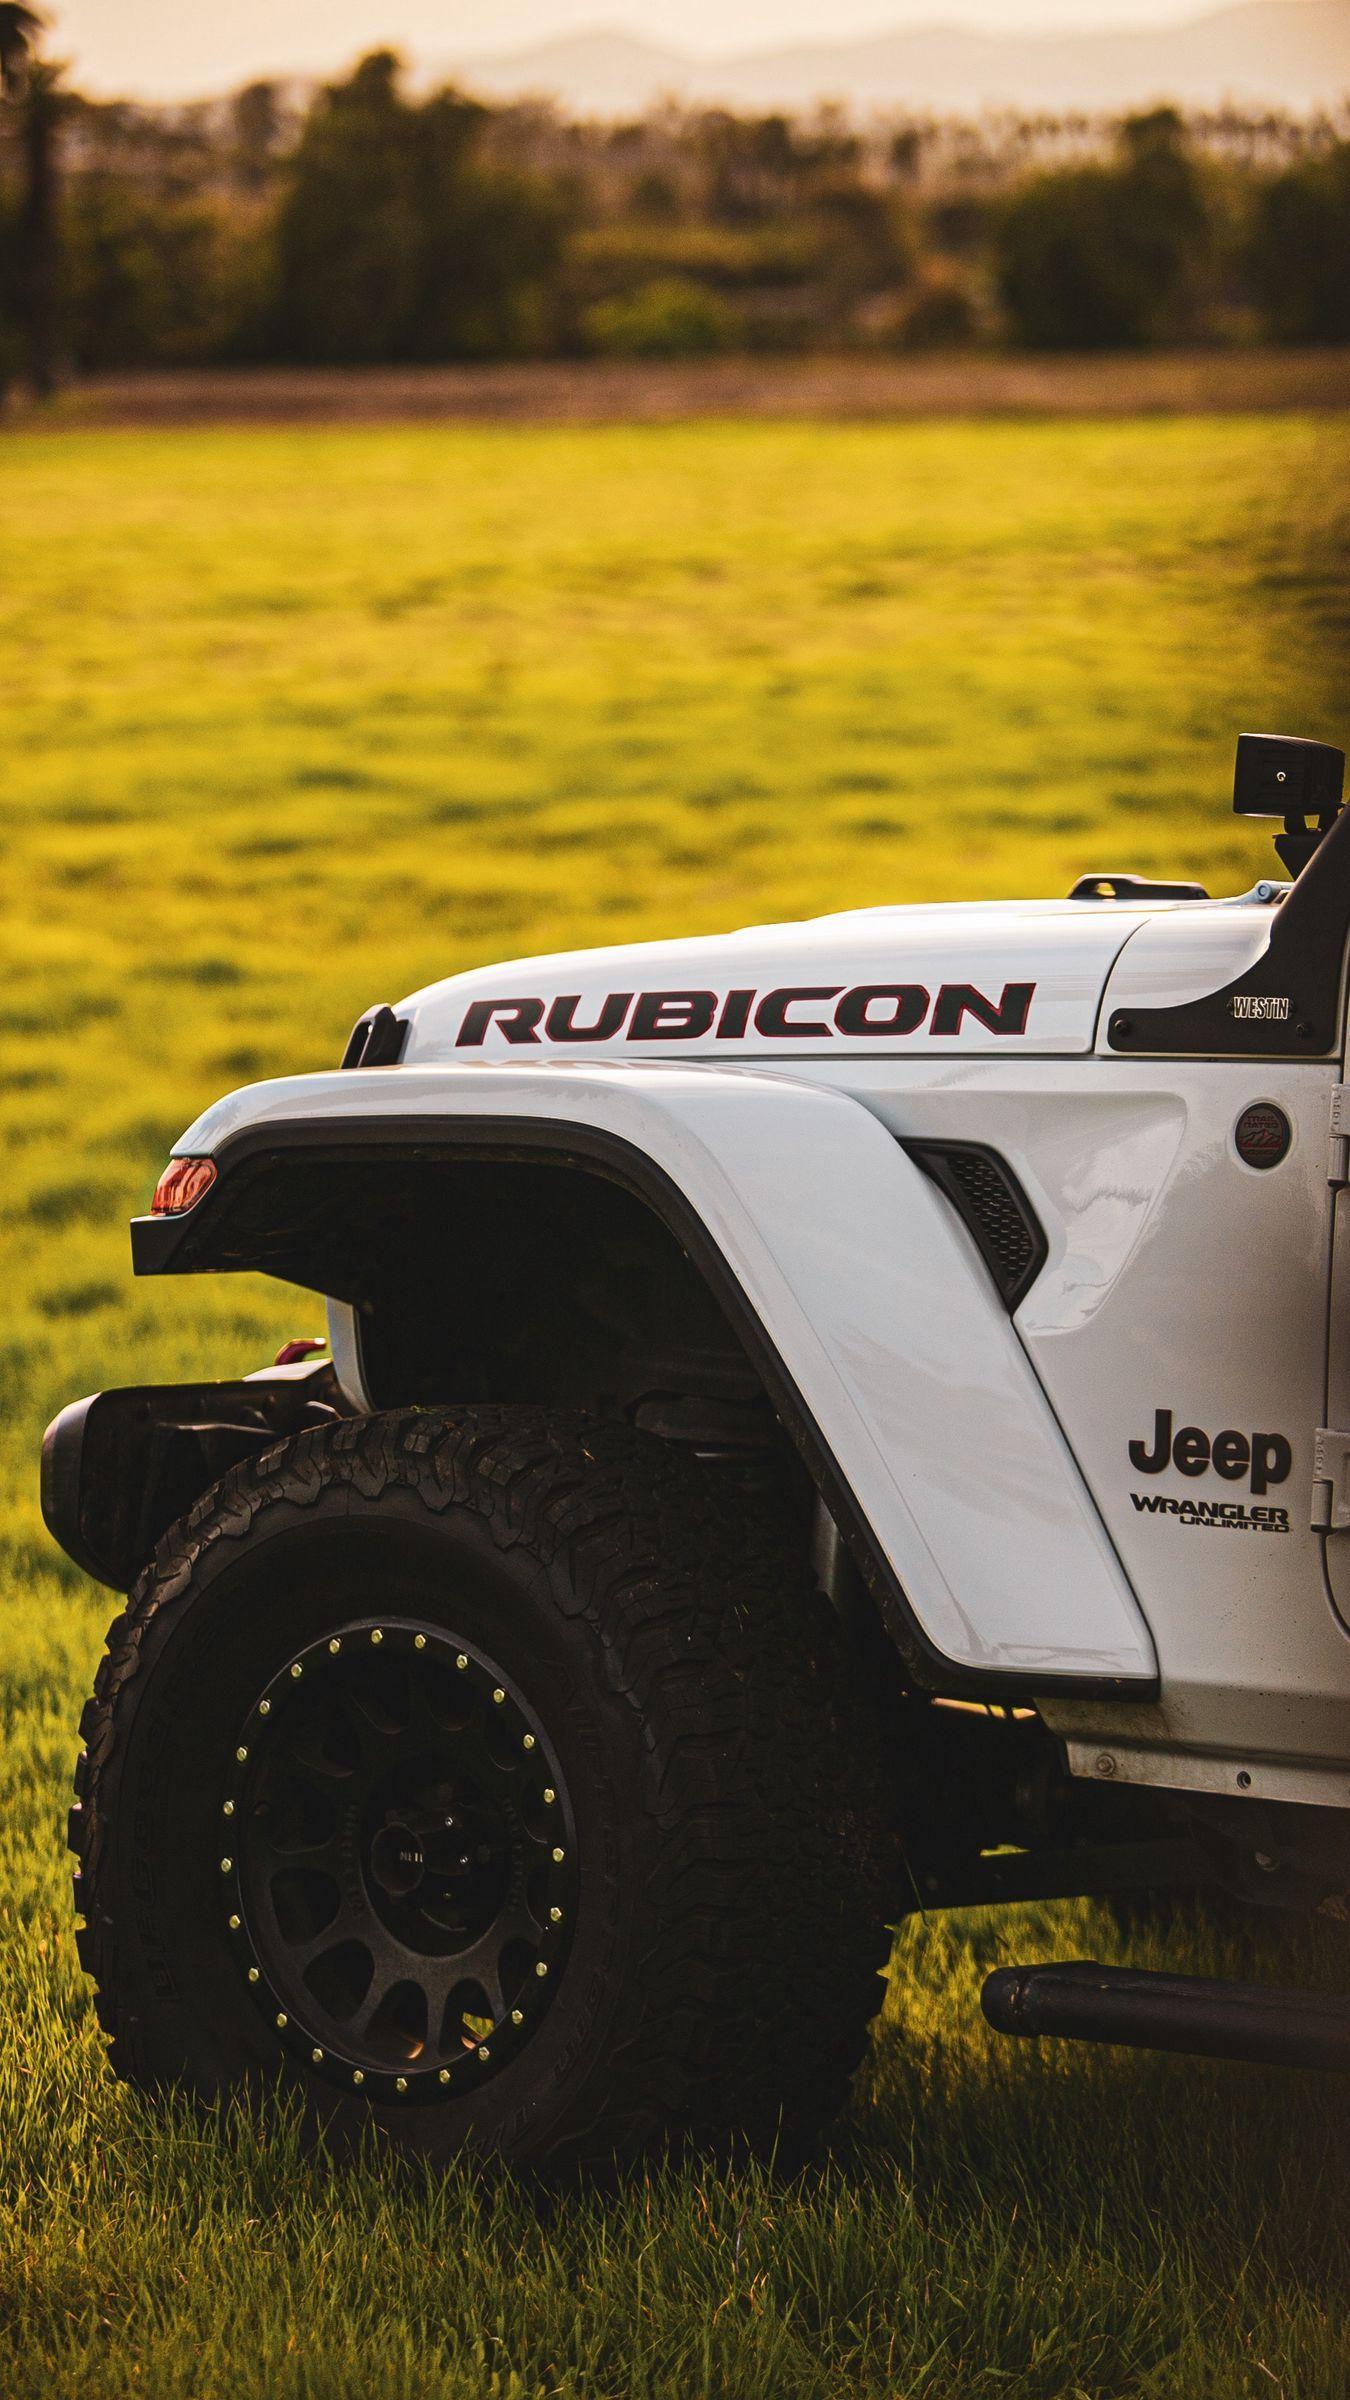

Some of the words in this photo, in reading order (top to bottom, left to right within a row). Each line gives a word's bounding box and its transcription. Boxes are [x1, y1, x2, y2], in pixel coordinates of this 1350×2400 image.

[454, 981, 1037, 1047] RUBICON
[1128, 1408, 1292, 1495] Jeep
[1129, 1493, 1289, 1525] WRANGLER
[1179, 1516, 1290, 1533] UNLIMITED
